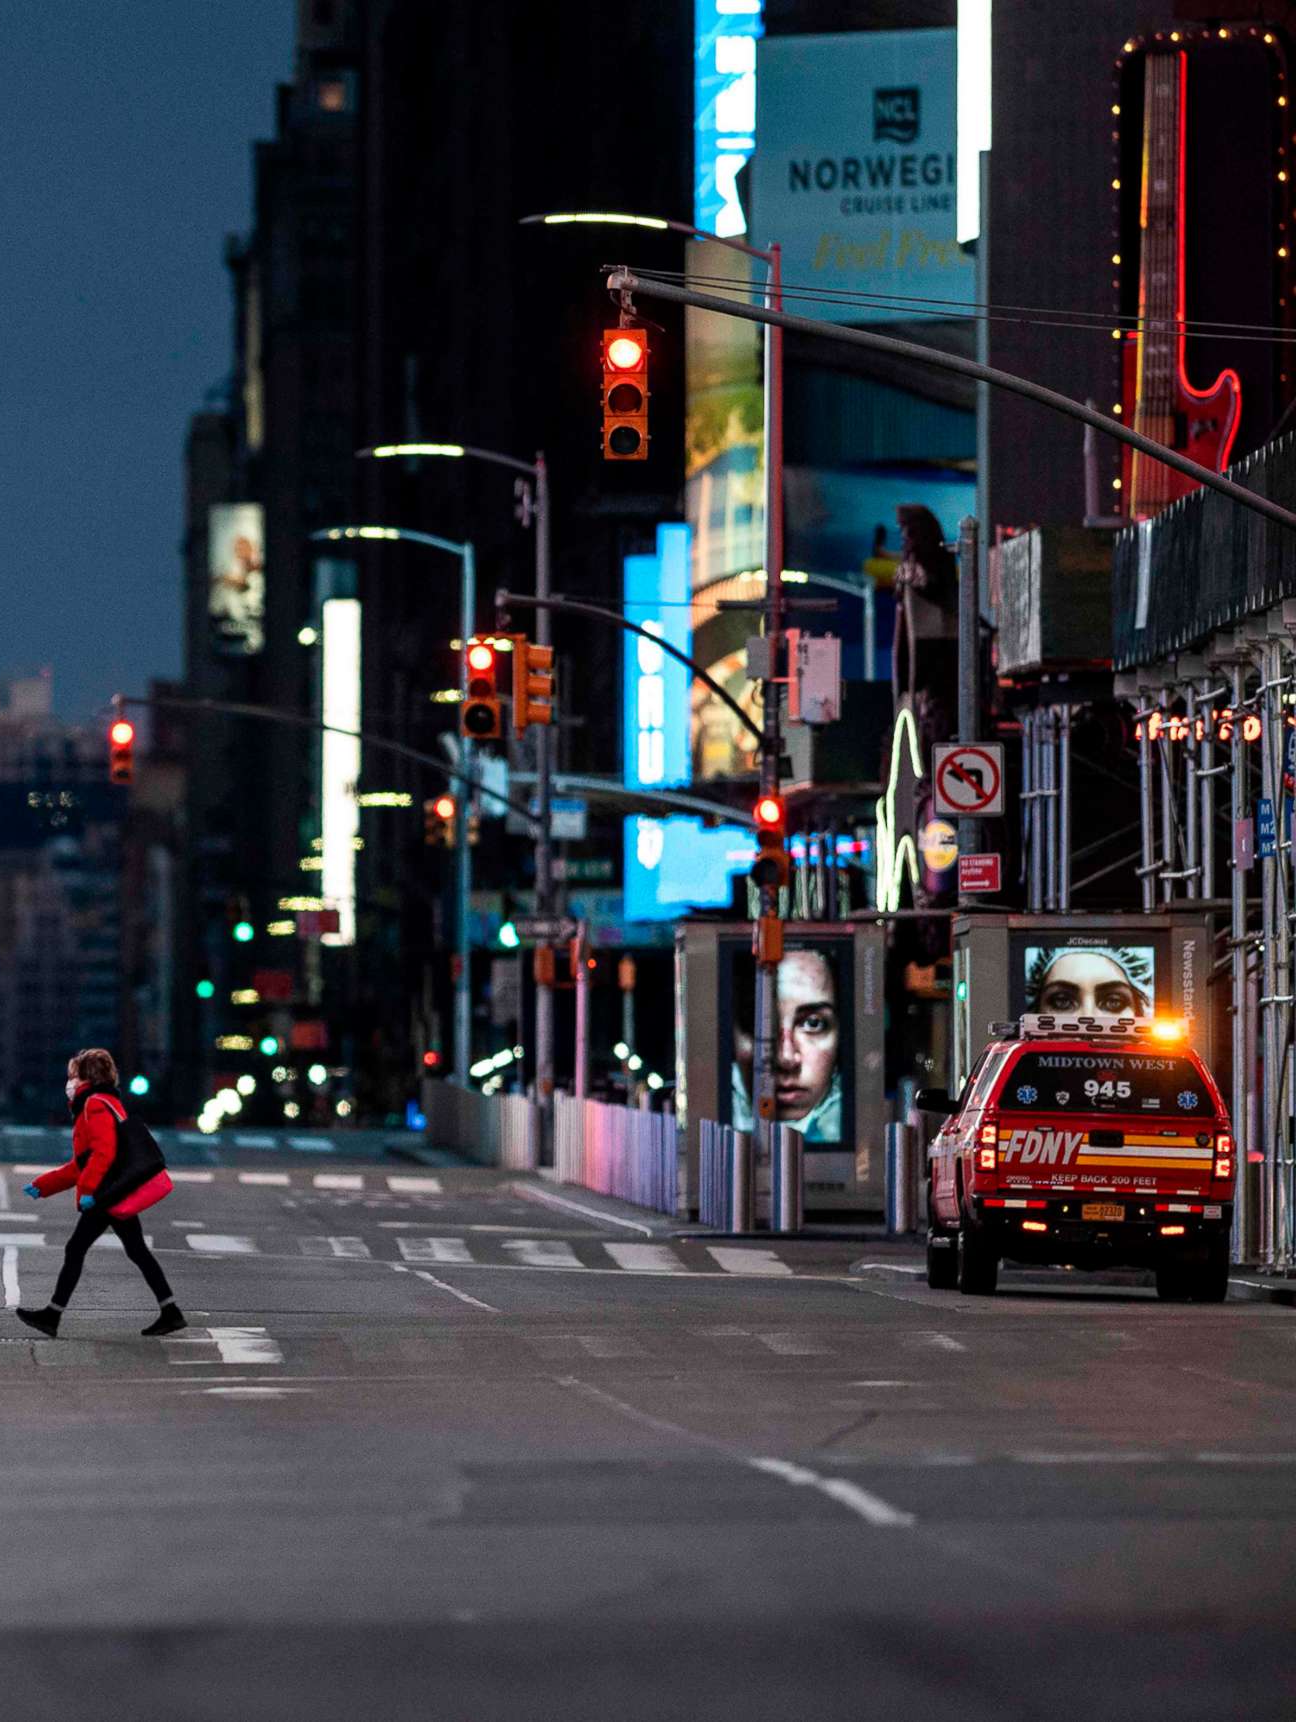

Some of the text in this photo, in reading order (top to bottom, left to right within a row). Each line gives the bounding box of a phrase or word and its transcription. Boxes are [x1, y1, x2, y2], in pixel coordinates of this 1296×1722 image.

[840, 193, 952, 216] CRUISE LINE
[1183, 939, 1196, 1022] Newsstand
[1038, 1055, 1177, 1071] MIDTOWN WEST
[1083, 1079, 1132, 1099] 945
[1004, 1129, 1083, 1166] FDNY
[1051, 1173, 1078, 1184] KEEP
[1080, 1174, 1107, 1185] BACK
[1111, 1175, 1130, 1185] 200
[1133, 1176, 1157, 1186] FEET
